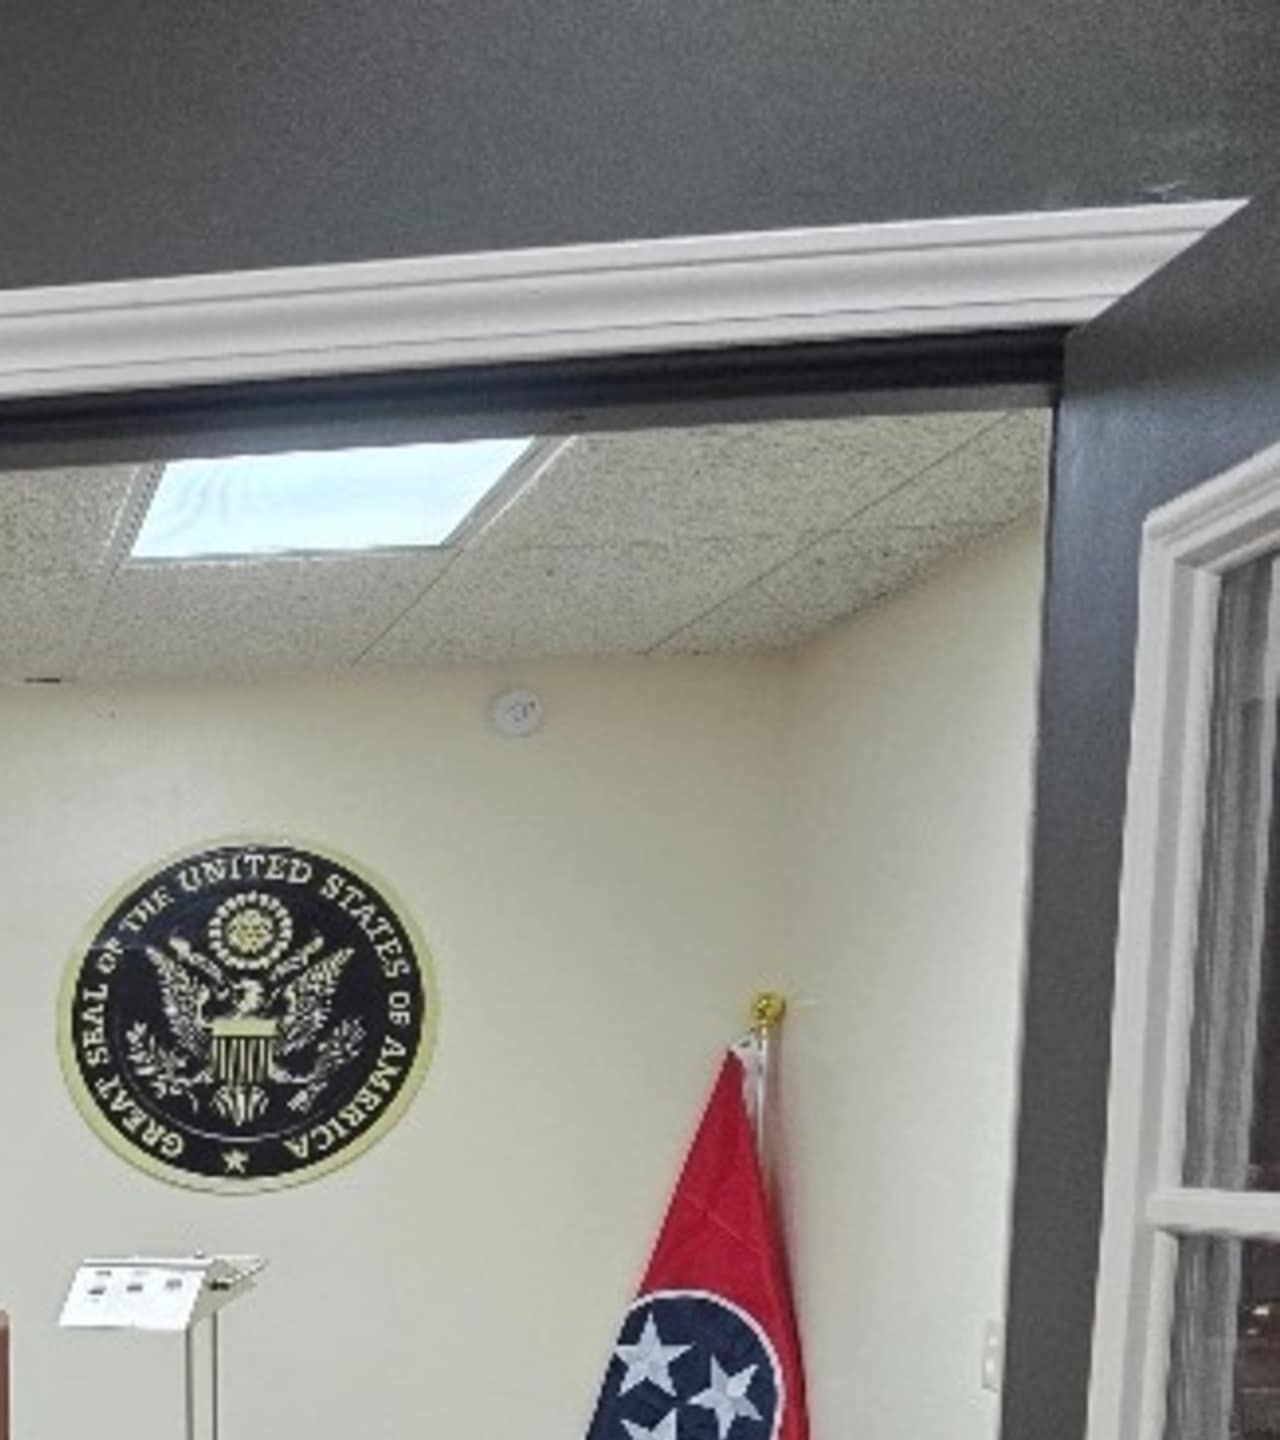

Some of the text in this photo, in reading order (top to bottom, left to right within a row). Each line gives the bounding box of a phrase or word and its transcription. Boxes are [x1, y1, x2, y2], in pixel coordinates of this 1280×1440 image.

[82, 853, 412, 1159] GREAT SEAL OF THE UNITED STATES OF AMERICA
